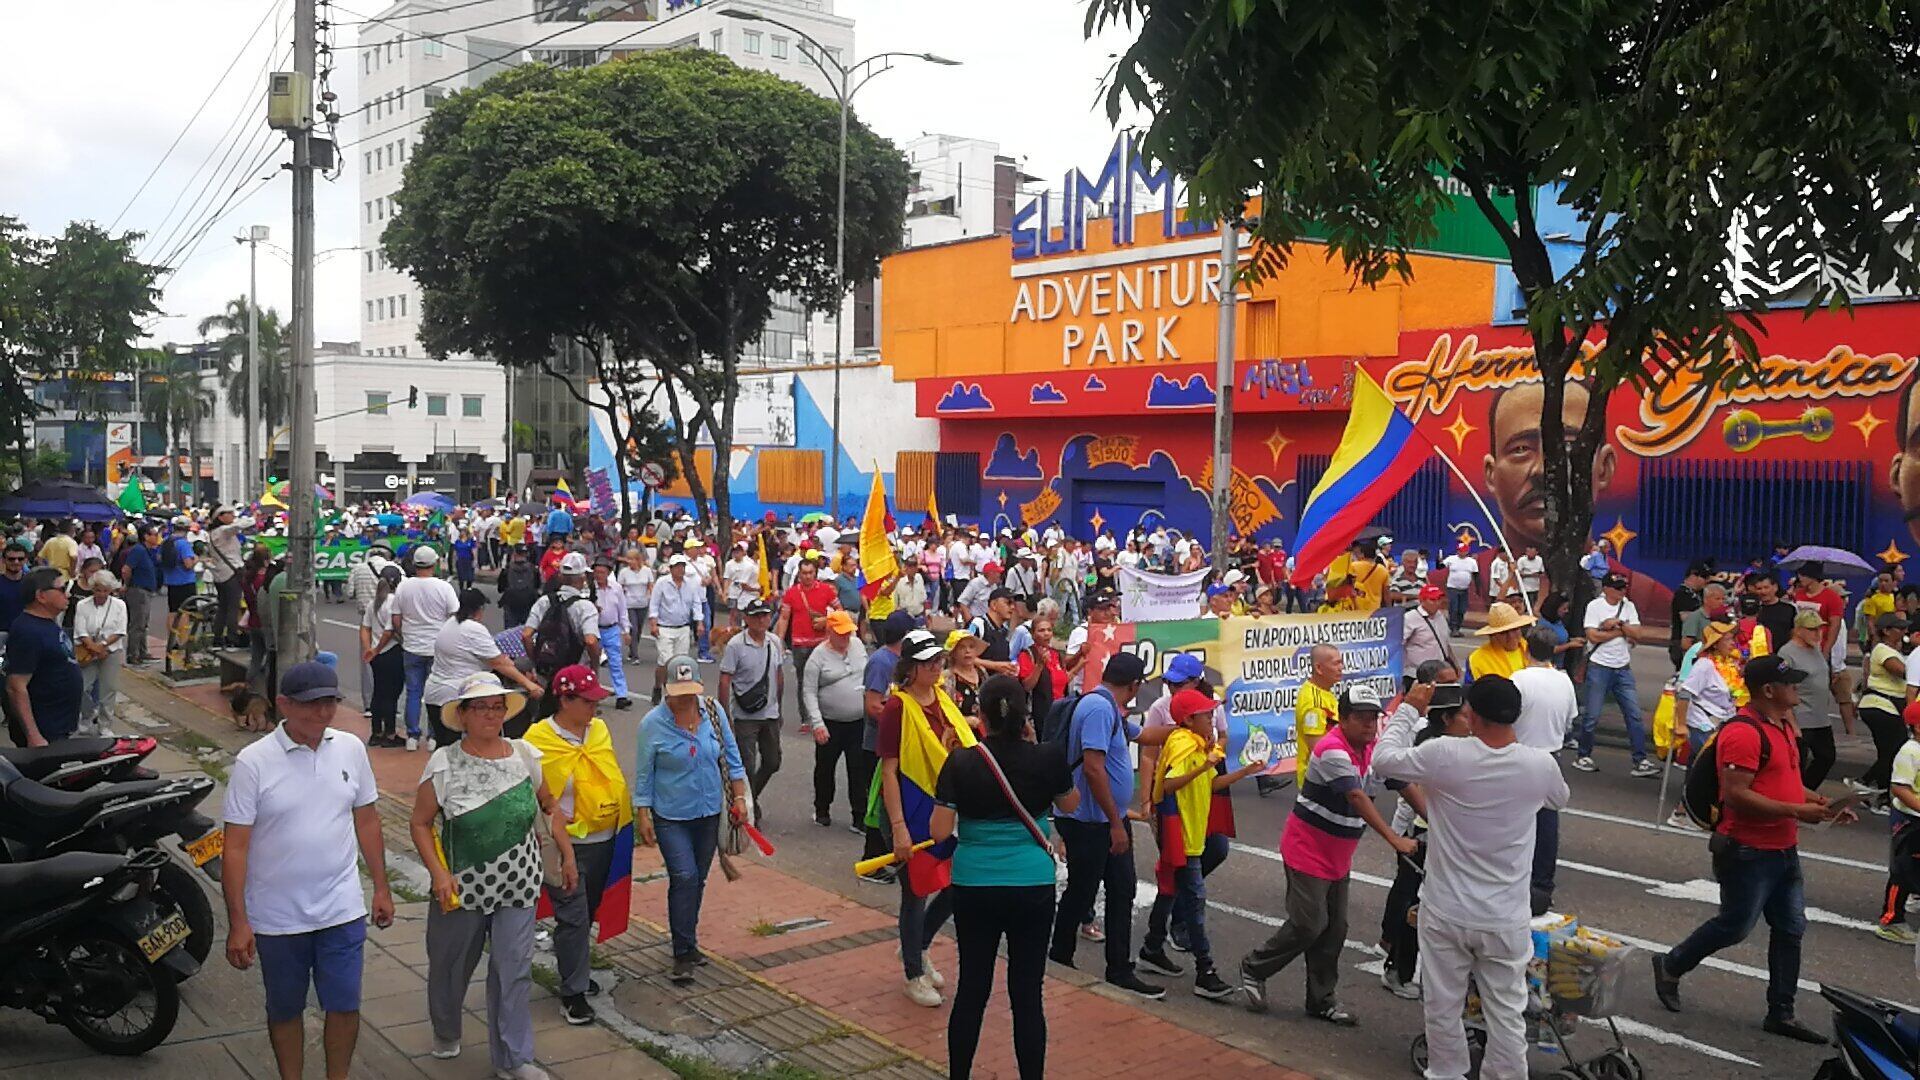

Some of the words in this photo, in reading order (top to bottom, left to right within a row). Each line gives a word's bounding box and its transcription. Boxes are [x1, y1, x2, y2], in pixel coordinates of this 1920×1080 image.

[1062, 315, 1181, 366] PARK
[1245, 628, 1260, 649] EN
[1262, 625, 1301, 647] APOYO
[1311, 622, 1330, 644] LAS
[1331, 617, 1387, 642] REFORMAS
[1231, 689, 1274, 715] SALUD
[1275, 687, 1297, 712] QUE
